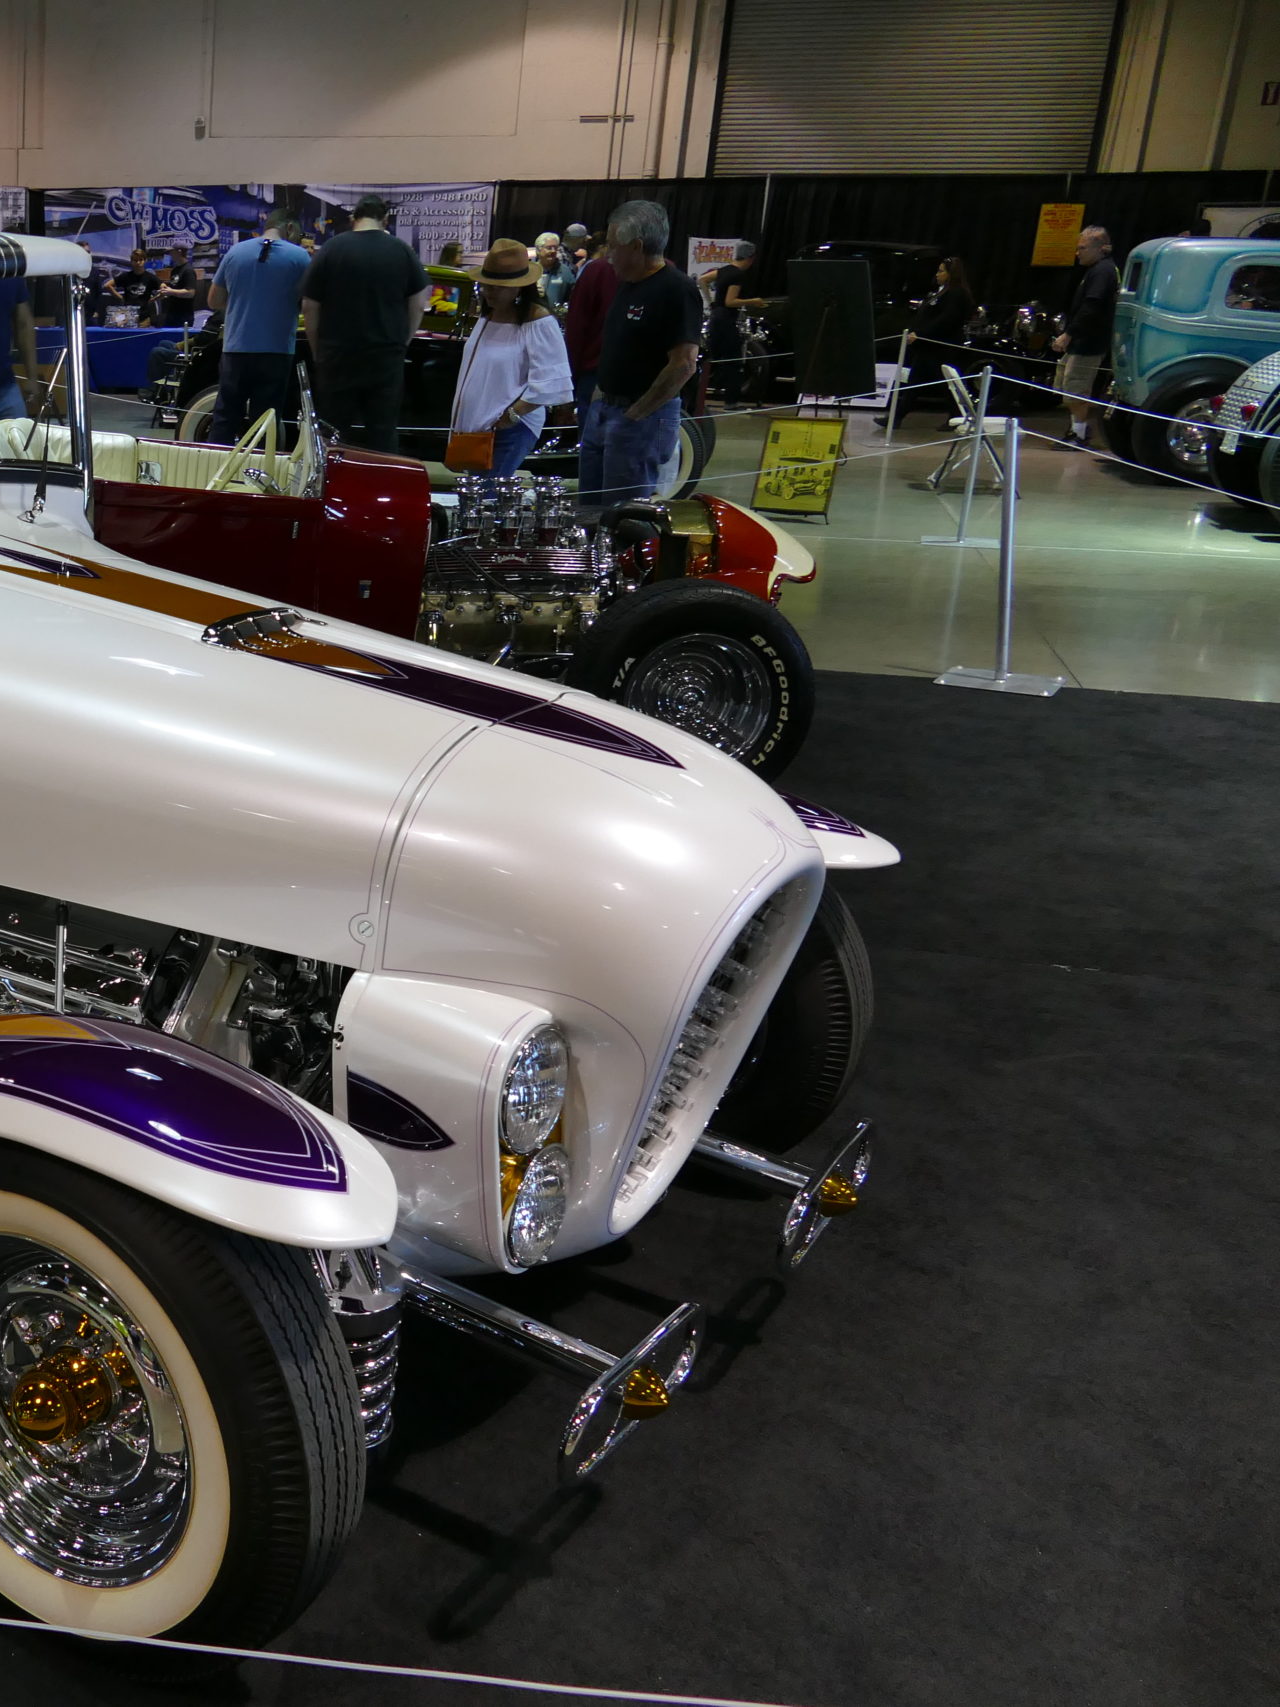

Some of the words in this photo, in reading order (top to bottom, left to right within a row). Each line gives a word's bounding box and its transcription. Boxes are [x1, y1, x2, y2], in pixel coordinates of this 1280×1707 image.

[145, 206, 217, 242] MOSS
[423, 207, 486, 216] Accessories
[750, 634, 789, 766] BFGoodrich
